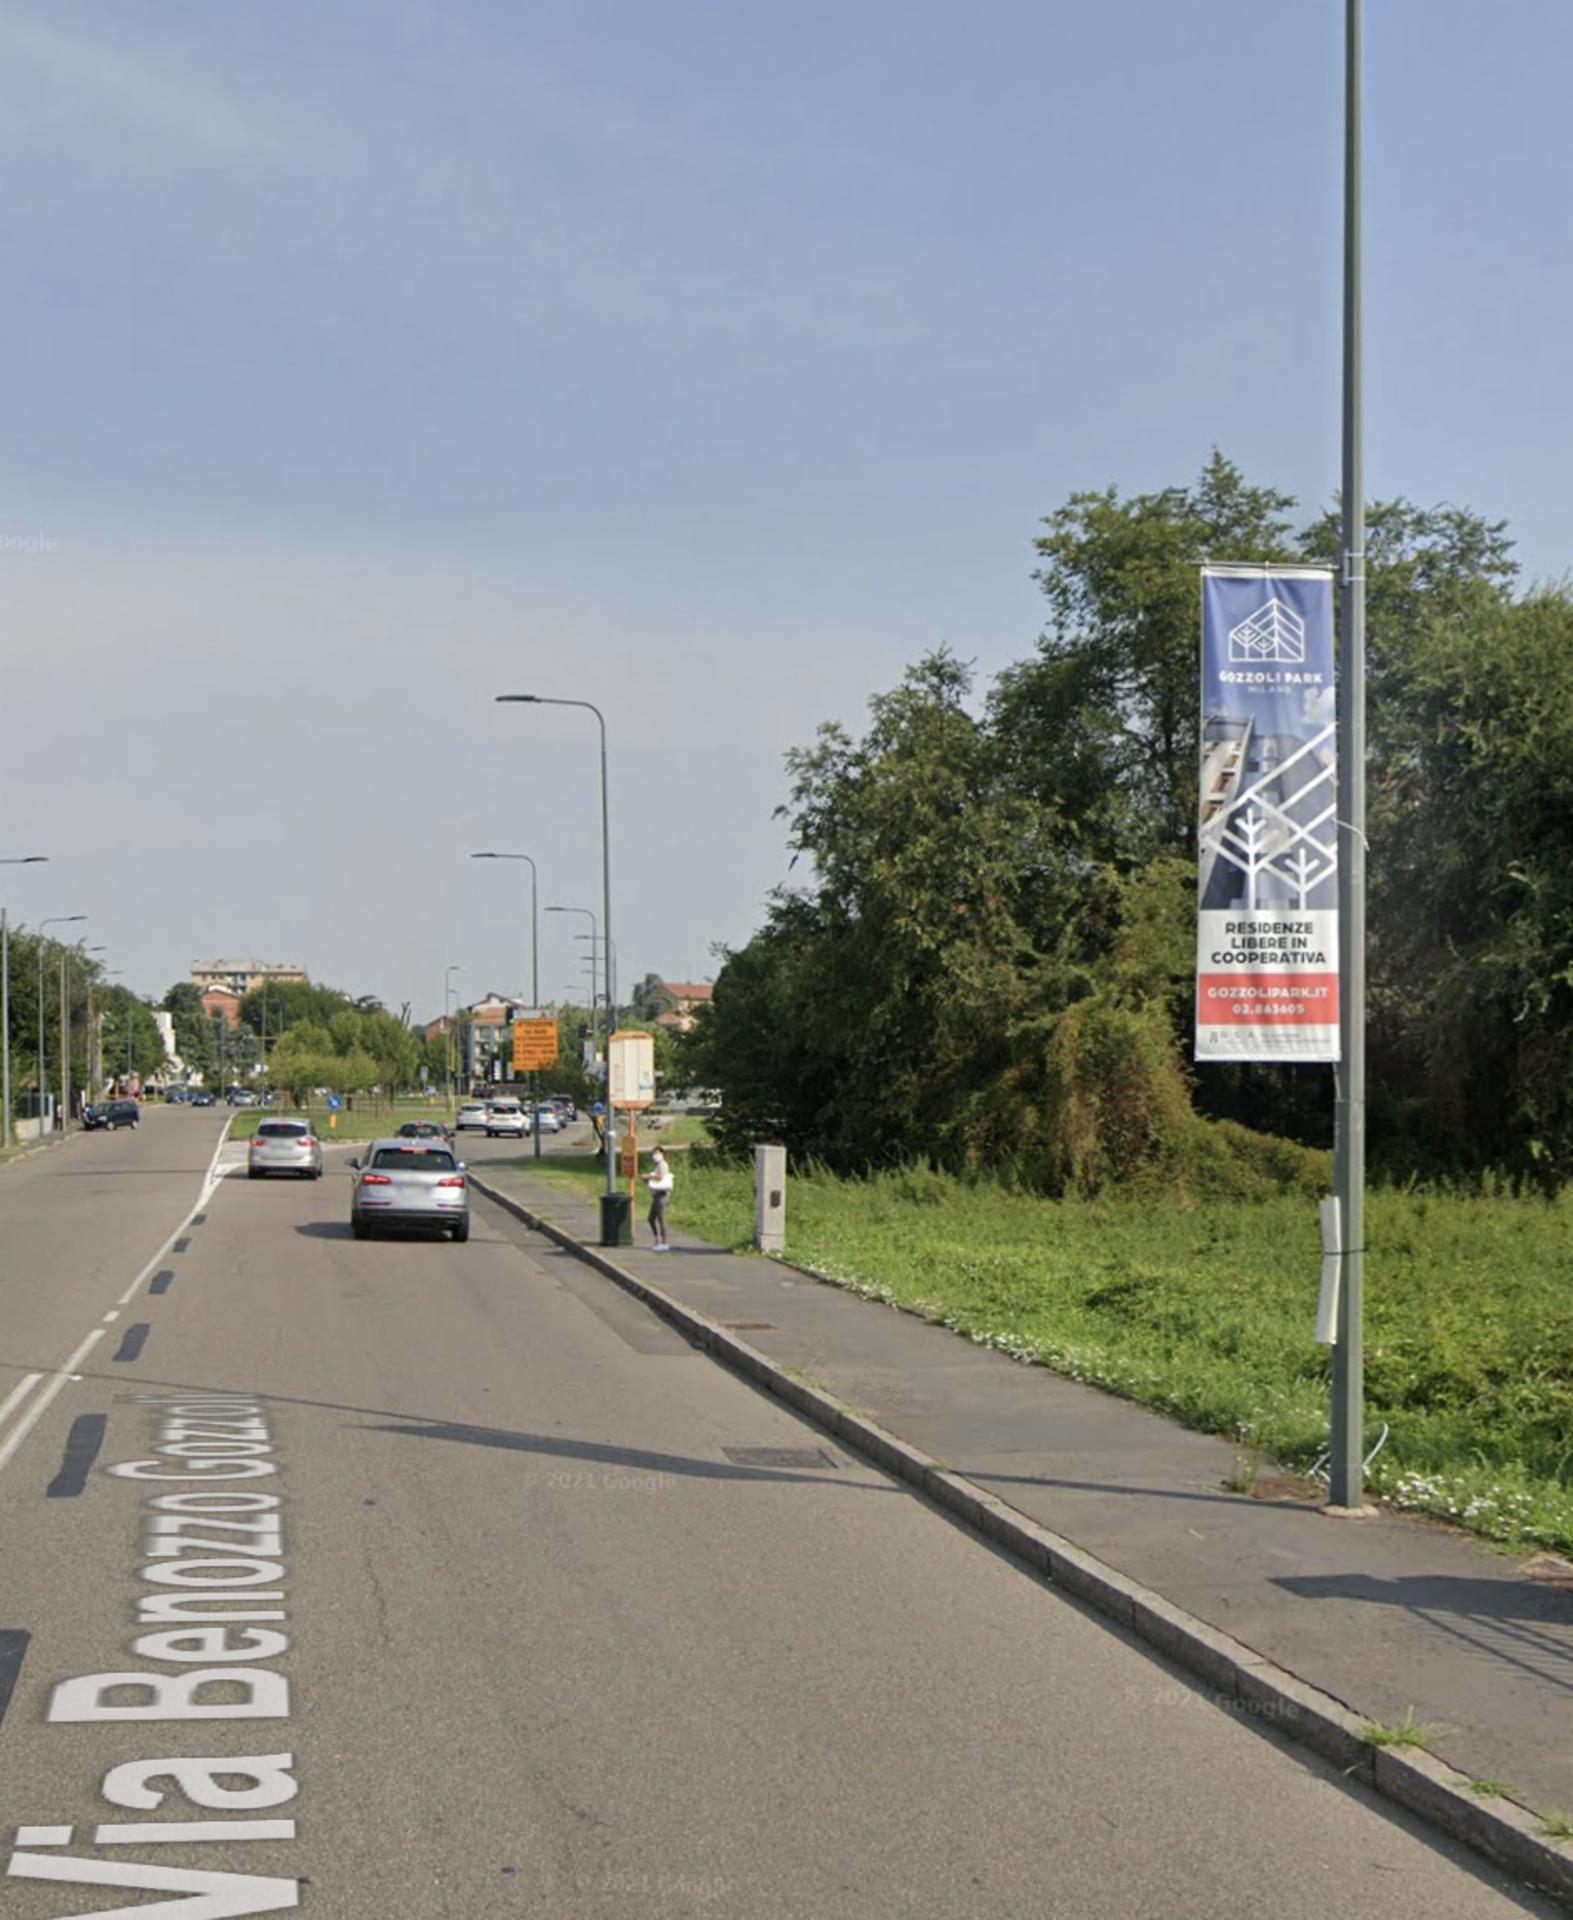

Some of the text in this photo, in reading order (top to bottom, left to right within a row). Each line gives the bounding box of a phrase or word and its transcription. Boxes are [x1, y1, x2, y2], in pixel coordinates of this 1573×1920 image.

[1219, 670, 1323, 684] GOZZOLI PARK
[1225, 922, 1314, 934] RESIDENZE
[1231, 937, 1308, 949] LIBERE IN
[1211, 952, 1326, 964] COOPERATIVA
[1207, 987, 1329, 999] GOZZOLIPARK.IT
